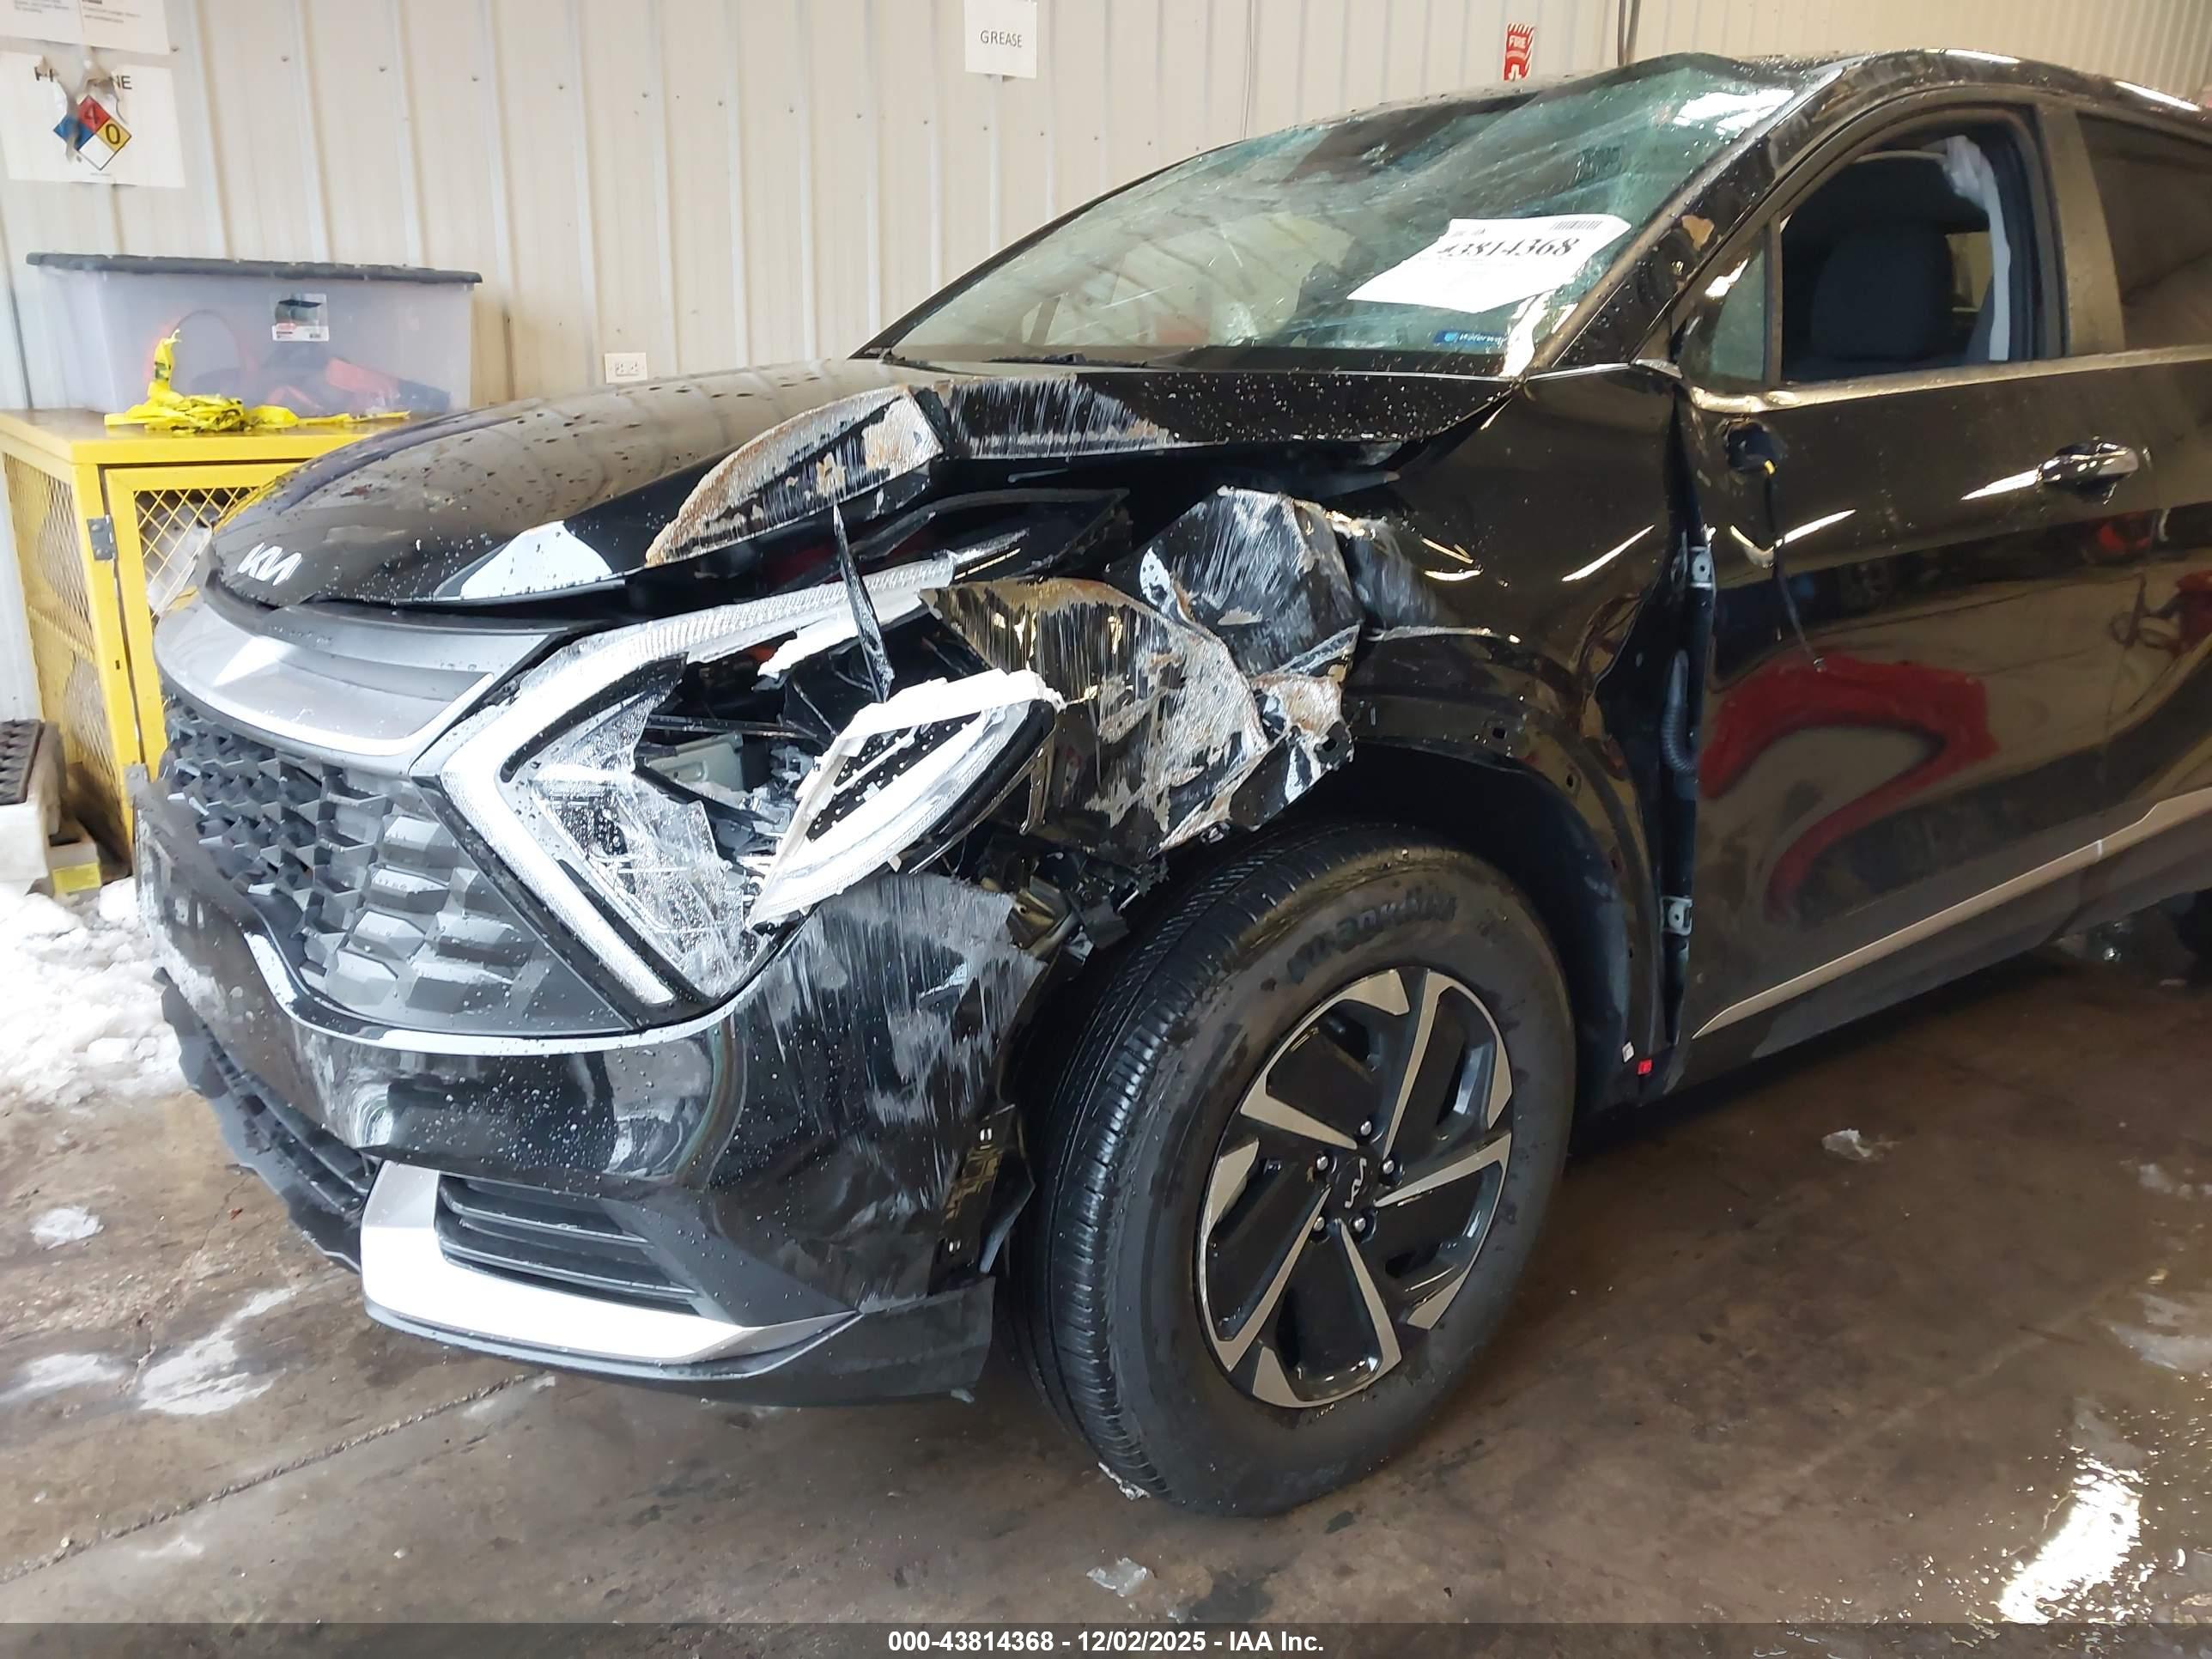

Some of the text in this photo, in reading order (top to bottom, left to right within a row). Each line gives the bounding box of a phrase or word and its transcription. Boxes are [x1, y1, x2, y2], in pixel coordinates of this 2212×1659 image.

[980, 29, 1023, 48] GREASE
[1509, 35, 1527, 49] FIRE
[84, 103, 100, 125] 4
[106, 123, 121, 145] 0
